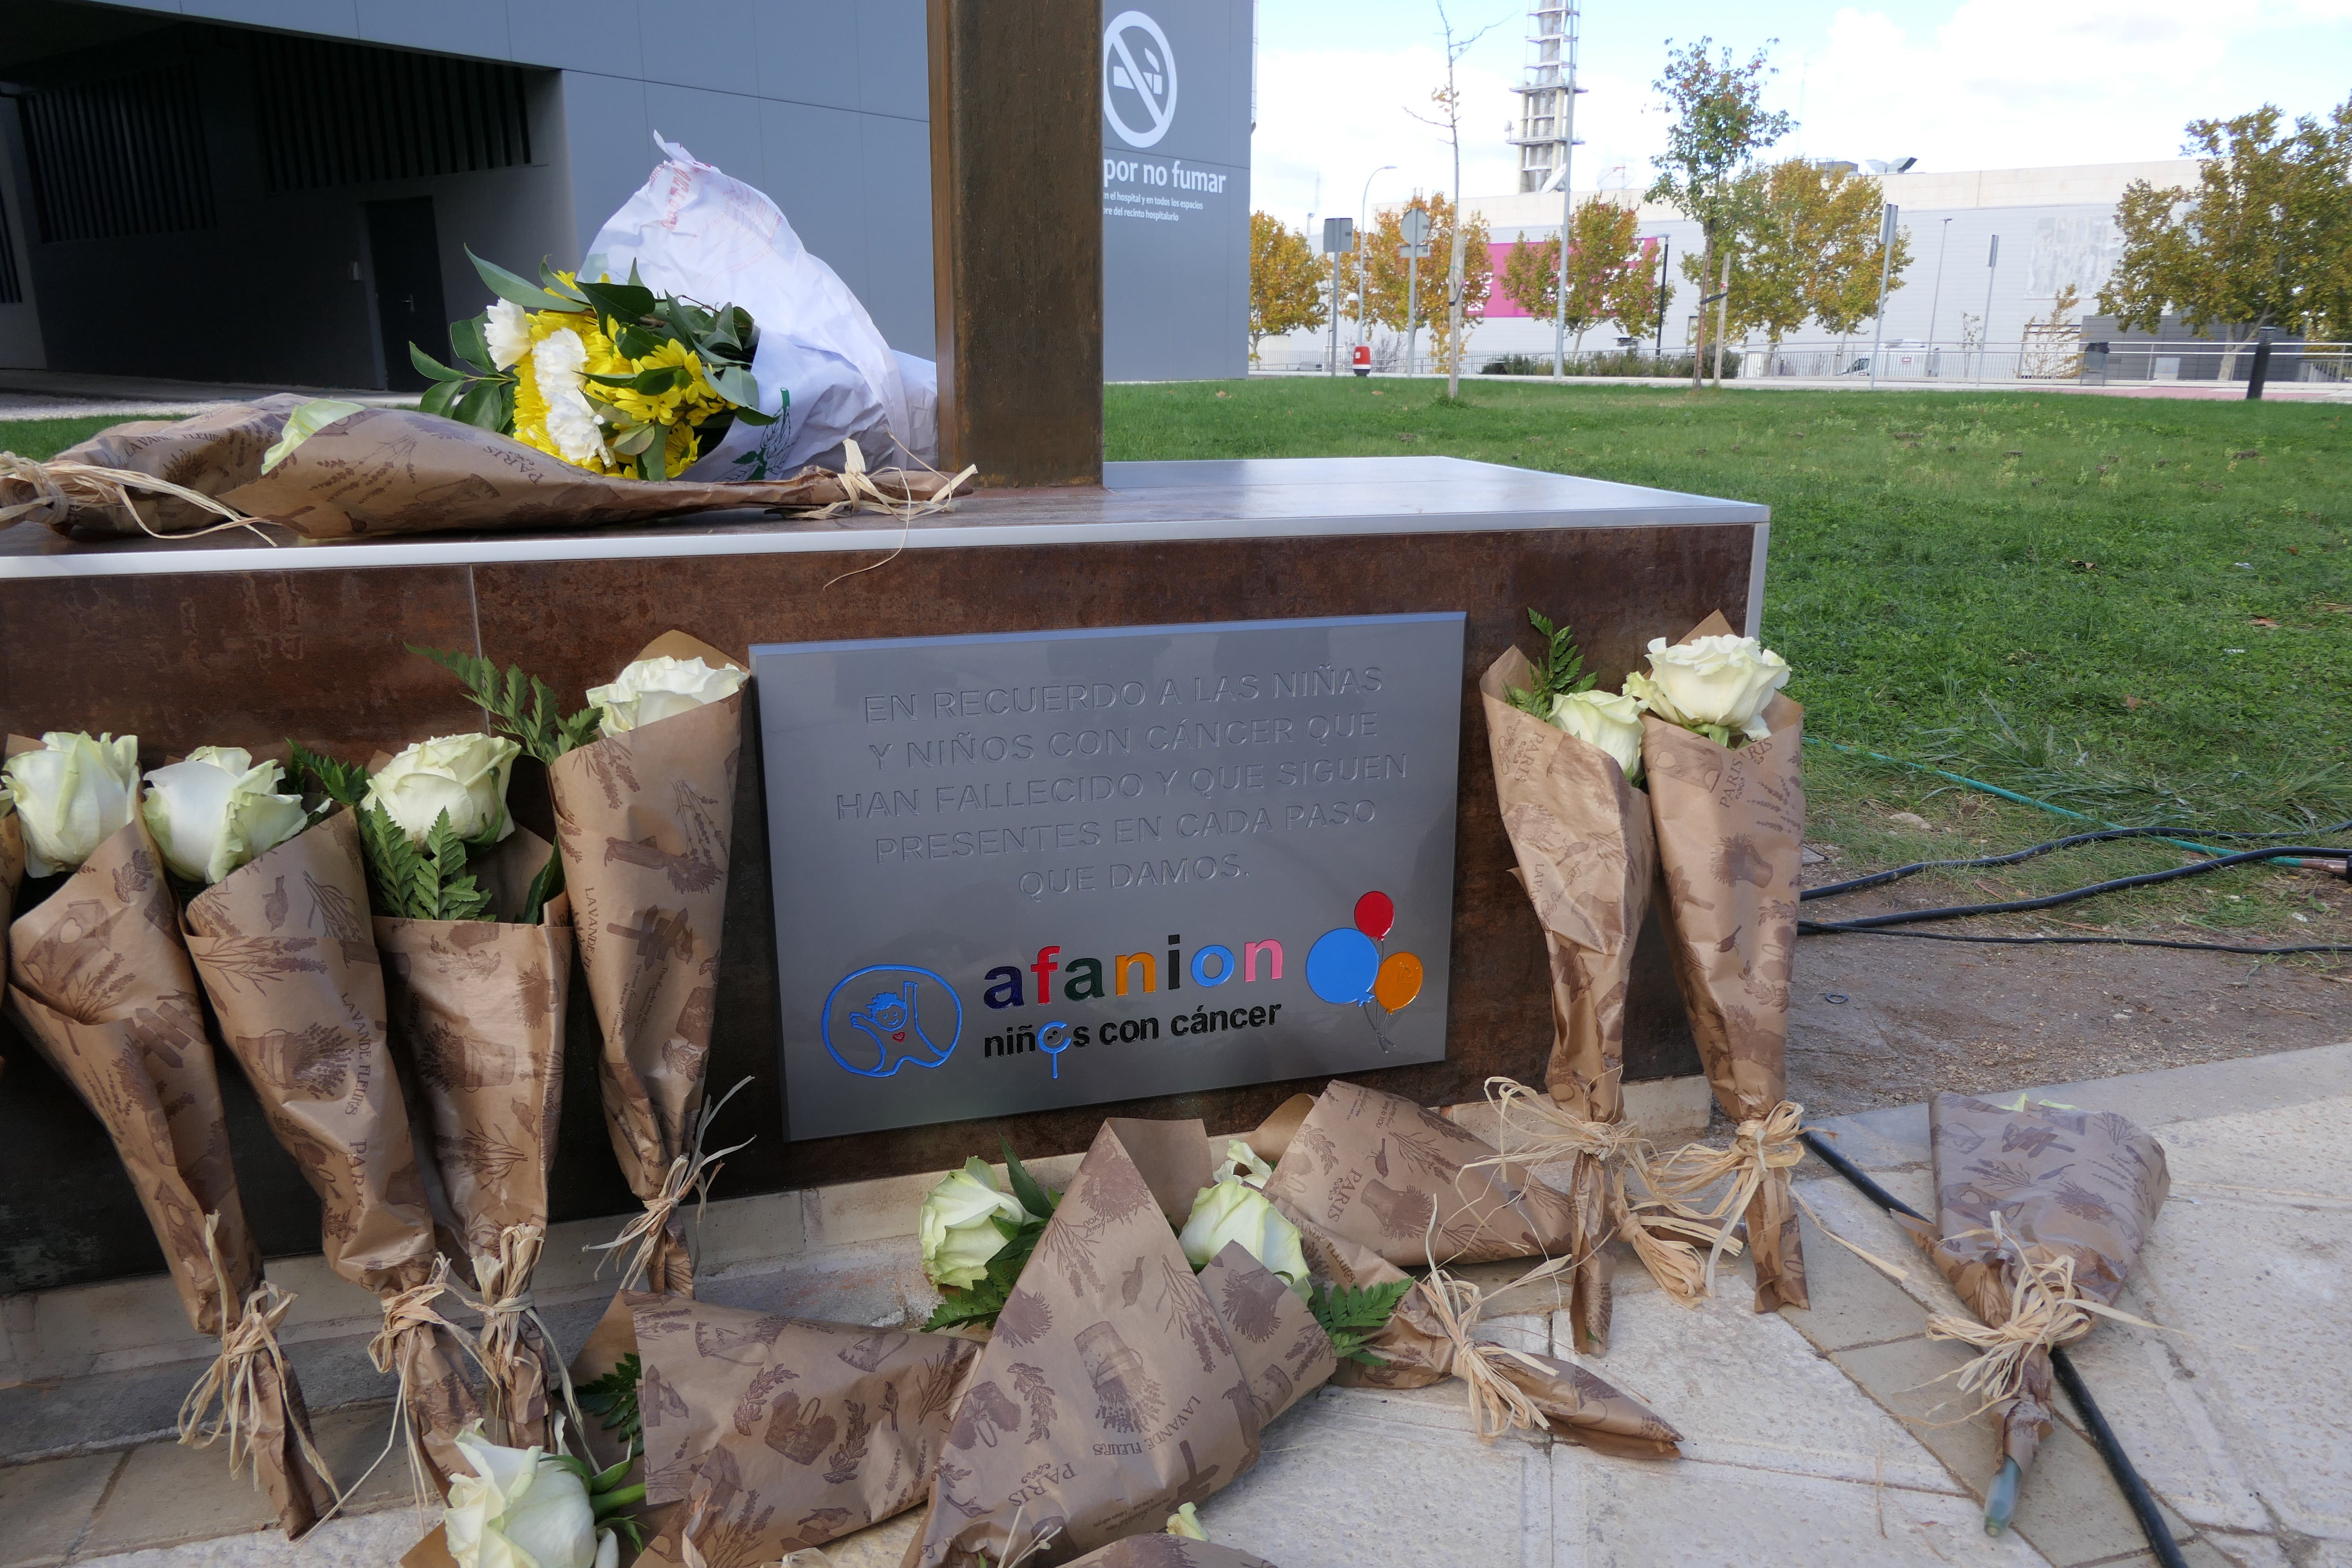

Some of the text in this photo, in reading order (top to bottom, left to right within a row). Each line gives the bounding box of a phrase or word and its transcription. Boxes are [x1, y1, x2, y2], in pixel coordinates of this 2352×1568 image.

[1103, 159, 1226, 193] por no fumar
[1110, 191, 1116, 200] el
[1117, 192, 1141, 204] hospital
[1141, 197, 1145, 205] y
[1155, 197, 1170, 207] todos
[1171, 198, 1179, 207] los
[1180, 201, 1203, 210] espacios
[1113, 207, 1123, 216] del
[1124, 208, 1145, 218] recinto
[1145, 210, 1179, 222] hospitalario
[483, 446, 546, 486] PARIS
[865, 664, 1382, 724] EN RECUERDO A LAS NIÑAS
[869, 712, 1377, 771] Y NIÑOS CON CÁNCER QUE
[1514, 730, 1546, 783] PARIS
[1740, 738, 1772, 760] RIS
[837, 753, 1406, 821] HAN FALLECIDO Y QUE SIGUEN
[1719, 758, 1743, 808] PARIS
[876, 799, 1375, 865] PRESENTES EN CADA PASO
[1018, 854, 1249, 903] QUE DAMOS.
[585, 887, 598, 954] LAVANDE
[983, 934, 1283, 1011] afanion
[1099, 1017, 1159, 1045] con
[1170, 1004, 1282, 1037] cáncer
[341, 991, 372, 1115] LAVANDE FLEURS
[1376, 1116, 1385, 1129] YOU
[1327, 1167, 1363, 1222] PARIS
[1083, 1216, 1099, 1226] YOU
[1286, 1217, 1327, 1243] VANDE
[816, 1326, 835, 1335] YOU
[853, 1337, 876, 1355] love
[1093, 1395, 1201, 1456] LAVANDE FLEURS
[1008, 1462, 1078, 1507] PARIS
